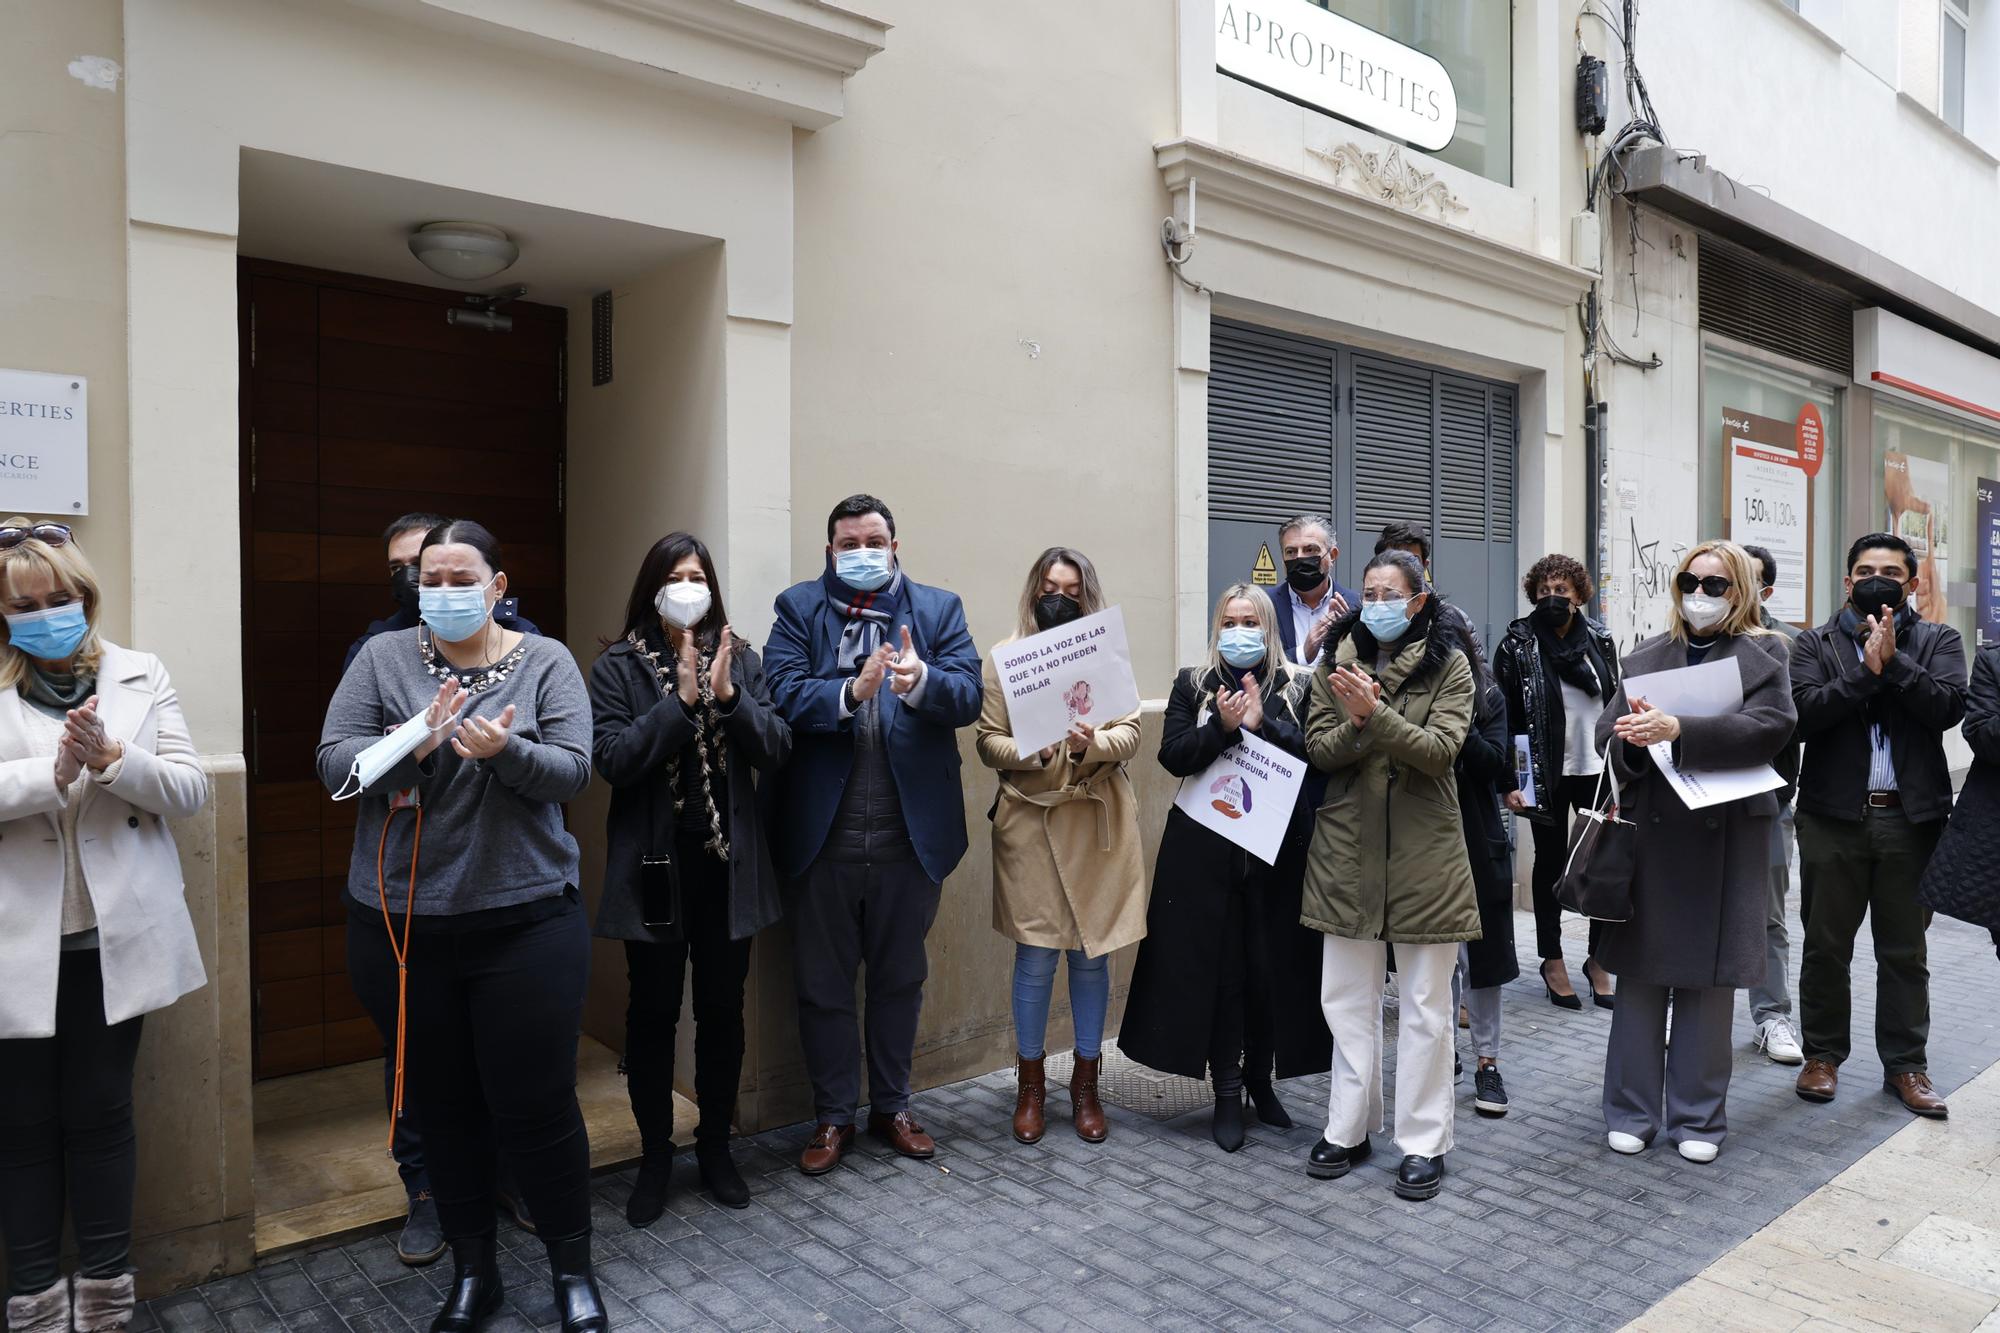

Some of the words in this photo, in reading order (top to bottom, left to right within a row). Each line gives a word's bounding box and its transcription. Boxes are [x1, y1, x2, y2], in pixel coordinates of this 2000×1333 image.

[1218, 3, 1441, 122] APROPERTIES
[1004, 651, 1039, 669] SOMOS
[1040, 646, 1053, 657] LA
[1054, 638, 1074, 651] VOZ
[1075, 633, 1088, 644] DE
[1089, 626, 1106, 639] LAS
[1009, 670, 1030, 684] QUE
[1031, 665, 1045, 675] YA
[1046, 659, 1060, 670] NO
[1061, 644, 1097, 664] PUEDEN
[1013, 678, 1051, 698] HABLAR
[1238, 743, 1250, 754] NO
[1271, 762, 1293, 778] PERO
